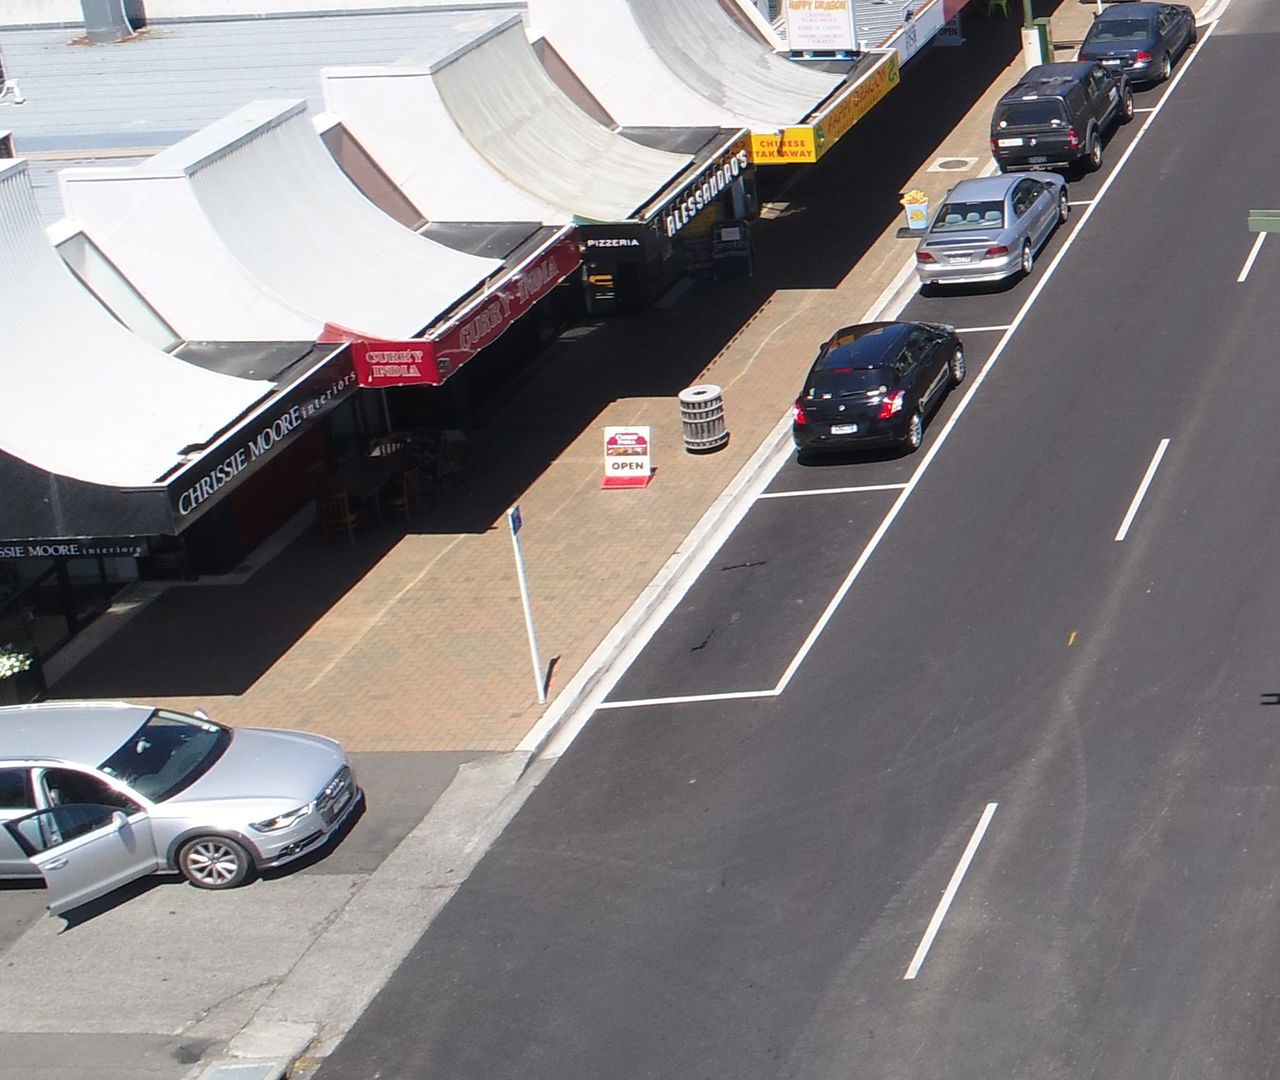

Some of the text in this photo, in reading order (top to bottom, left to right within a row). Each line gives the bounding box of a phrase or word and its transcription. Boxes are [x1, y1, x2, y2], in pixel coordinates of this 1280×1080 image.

[755, 150, 812, 158] TAKAWAY
[665, 149, 748, 238] ALESSANDRO'S
[587, 239, 640, 248] PIZZERIA
[365, 350, 424, 363] CURRY
[372, 365, 422, 378] INDIA
[178, 370, 357, 516] CHRISSIE MOORE interiors
[611, 462, 644, 470] OPEN
[28, 544, 80, 557] MOORE
[83, 546, 142, 555] interiors
